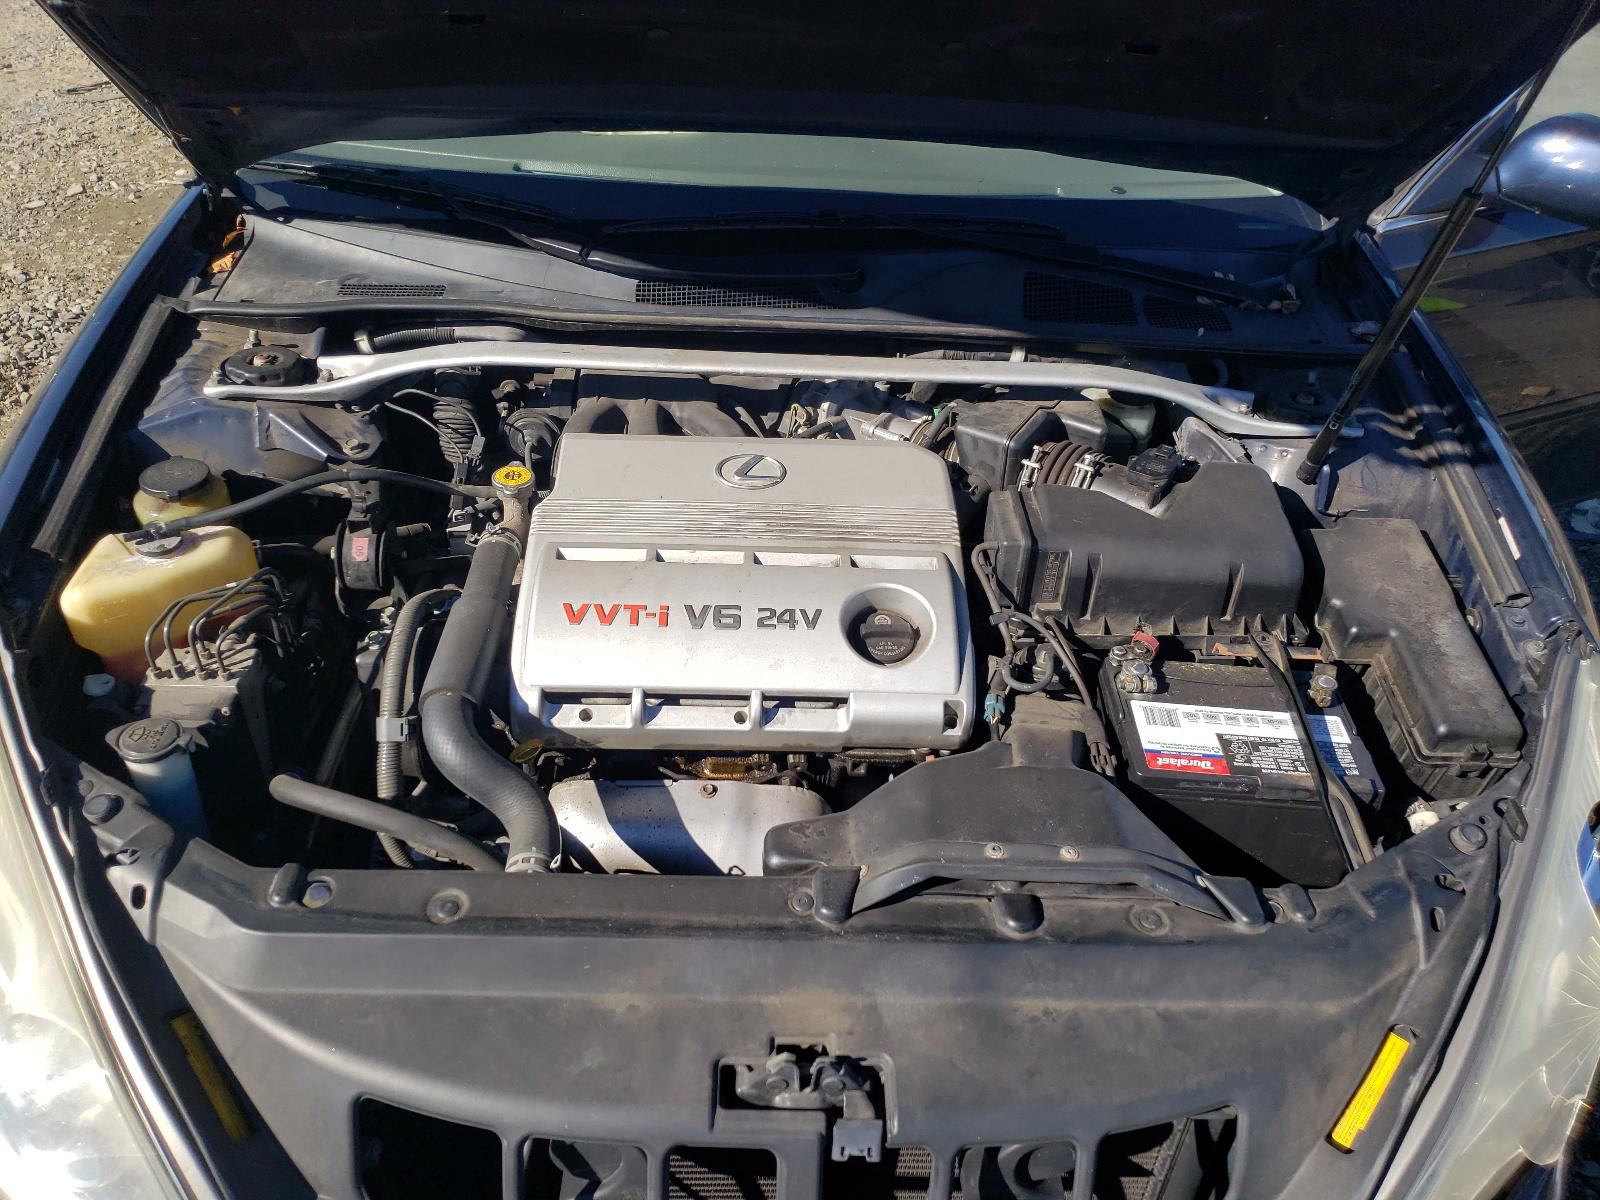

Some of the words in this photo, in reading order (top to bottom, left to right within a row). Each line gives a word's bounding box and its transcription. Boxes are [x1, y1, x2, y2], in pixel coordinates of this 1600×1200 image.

[562, 602, 670, 628] VVT-i
[684, 604, 742, 631] V6
[756, 607, 823, 631] 24V
[1156, 756, 1216, 771] Duralast
